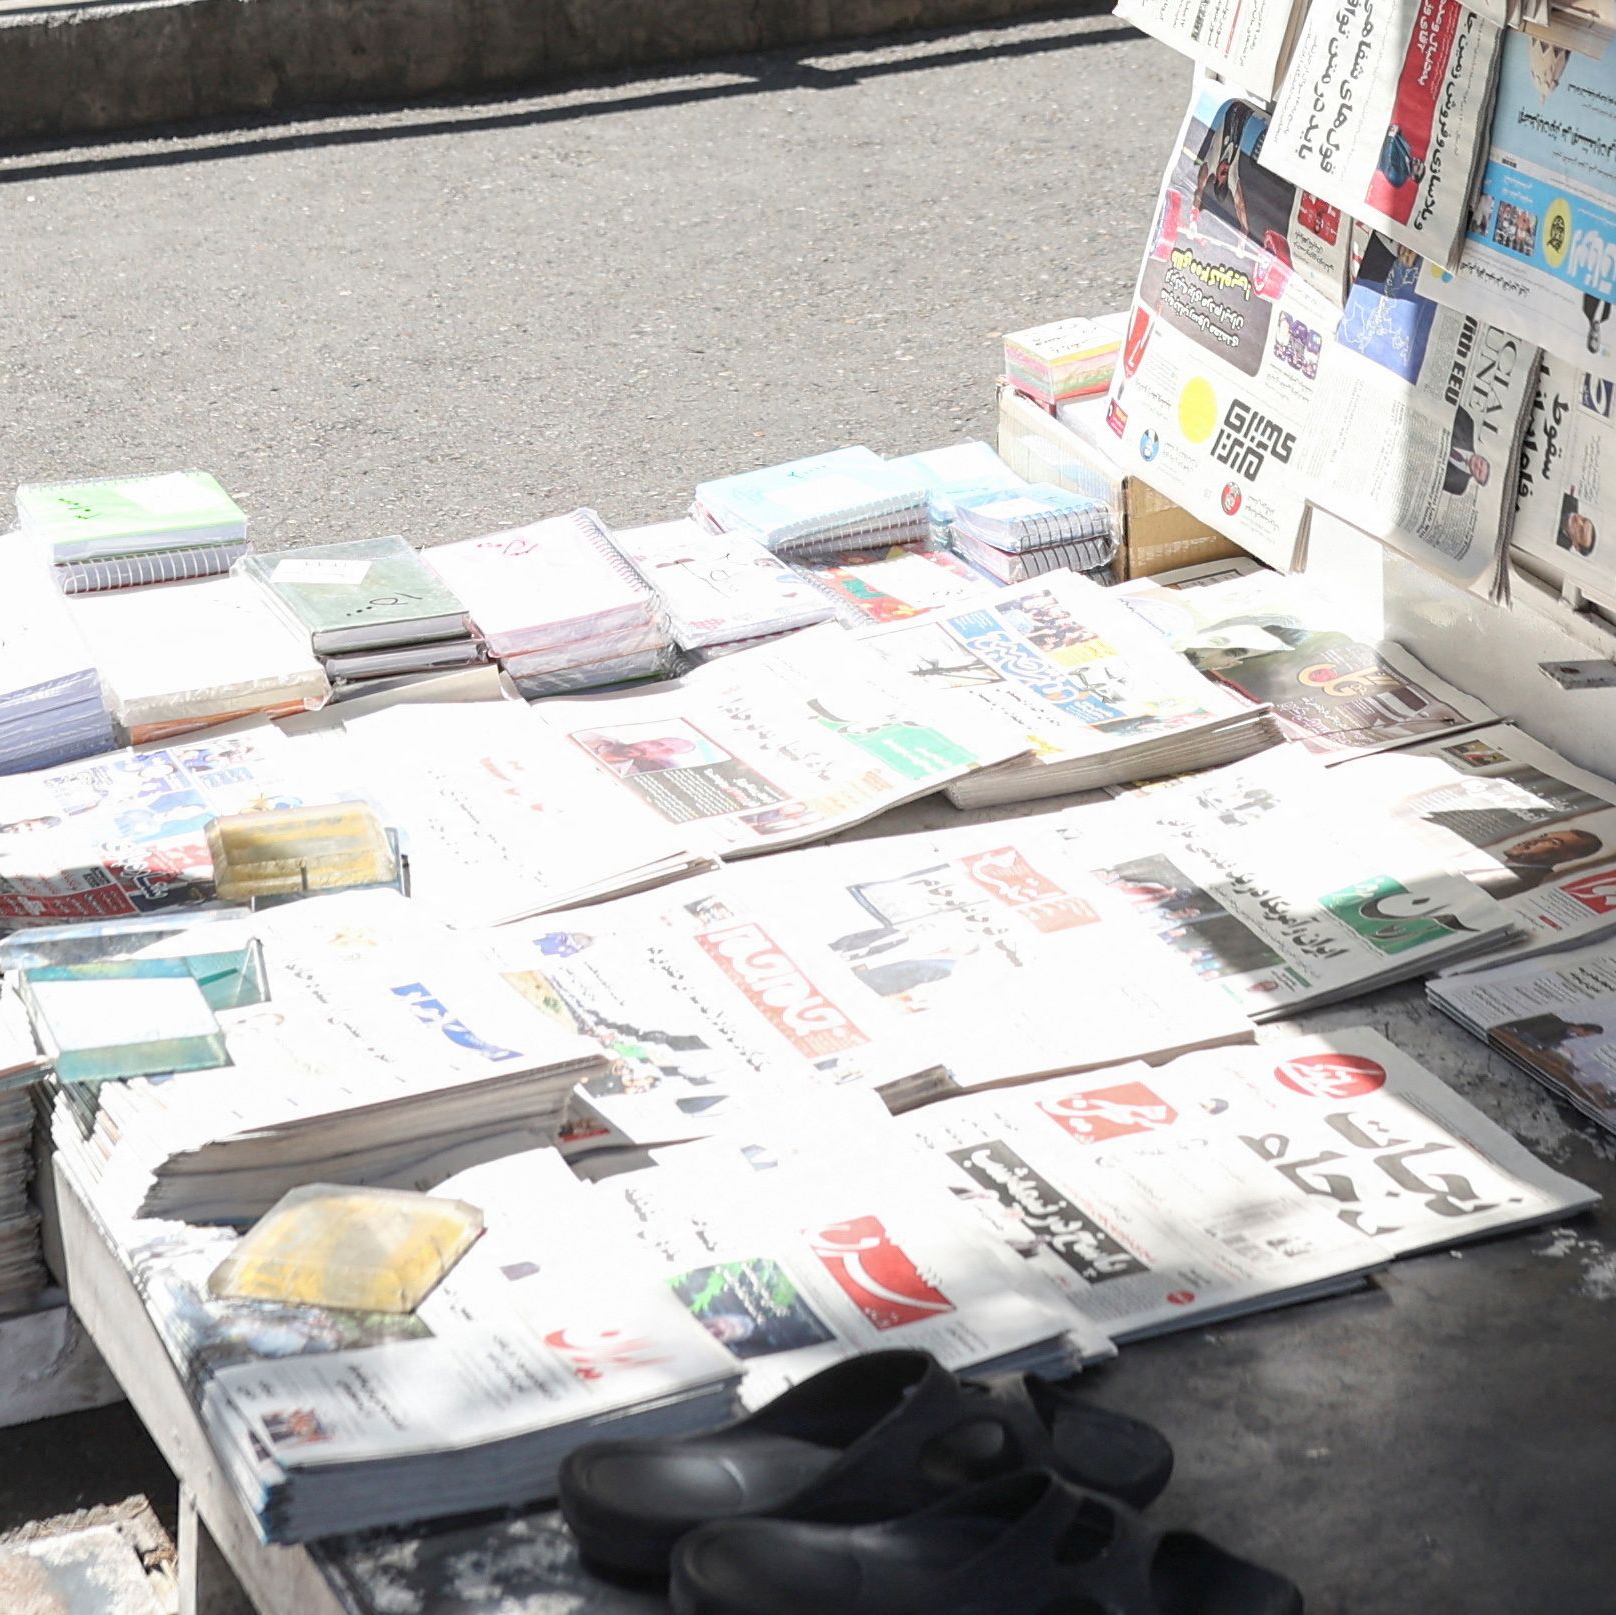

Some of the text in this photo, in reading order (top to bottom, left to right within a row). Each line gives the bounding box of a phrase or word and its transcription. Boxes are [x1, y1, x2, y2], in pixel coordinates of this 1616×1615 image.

[1416, 18, 1429, 53] آقای
[1450, 34, 1468, 79] زمین
[1297, 115, 1317, 161] باید
[1311, 81, 1322, 112] در
[1319, 36, 1339, 84] متن
[1437, 80, 1456, 133] فروش
[1434, 132, 1449, 147] و
[1413, 148, 1441, 232] ویلاسازی
[1200, 295, 1222, 316] مردم
[1219, 307, 1243, 331] ایران
[1443, 361, 1465, 405] EEU
[1542, 393, 1568, 479] سقوط
[1085, 1236, 1133, 1280] پاسخ
